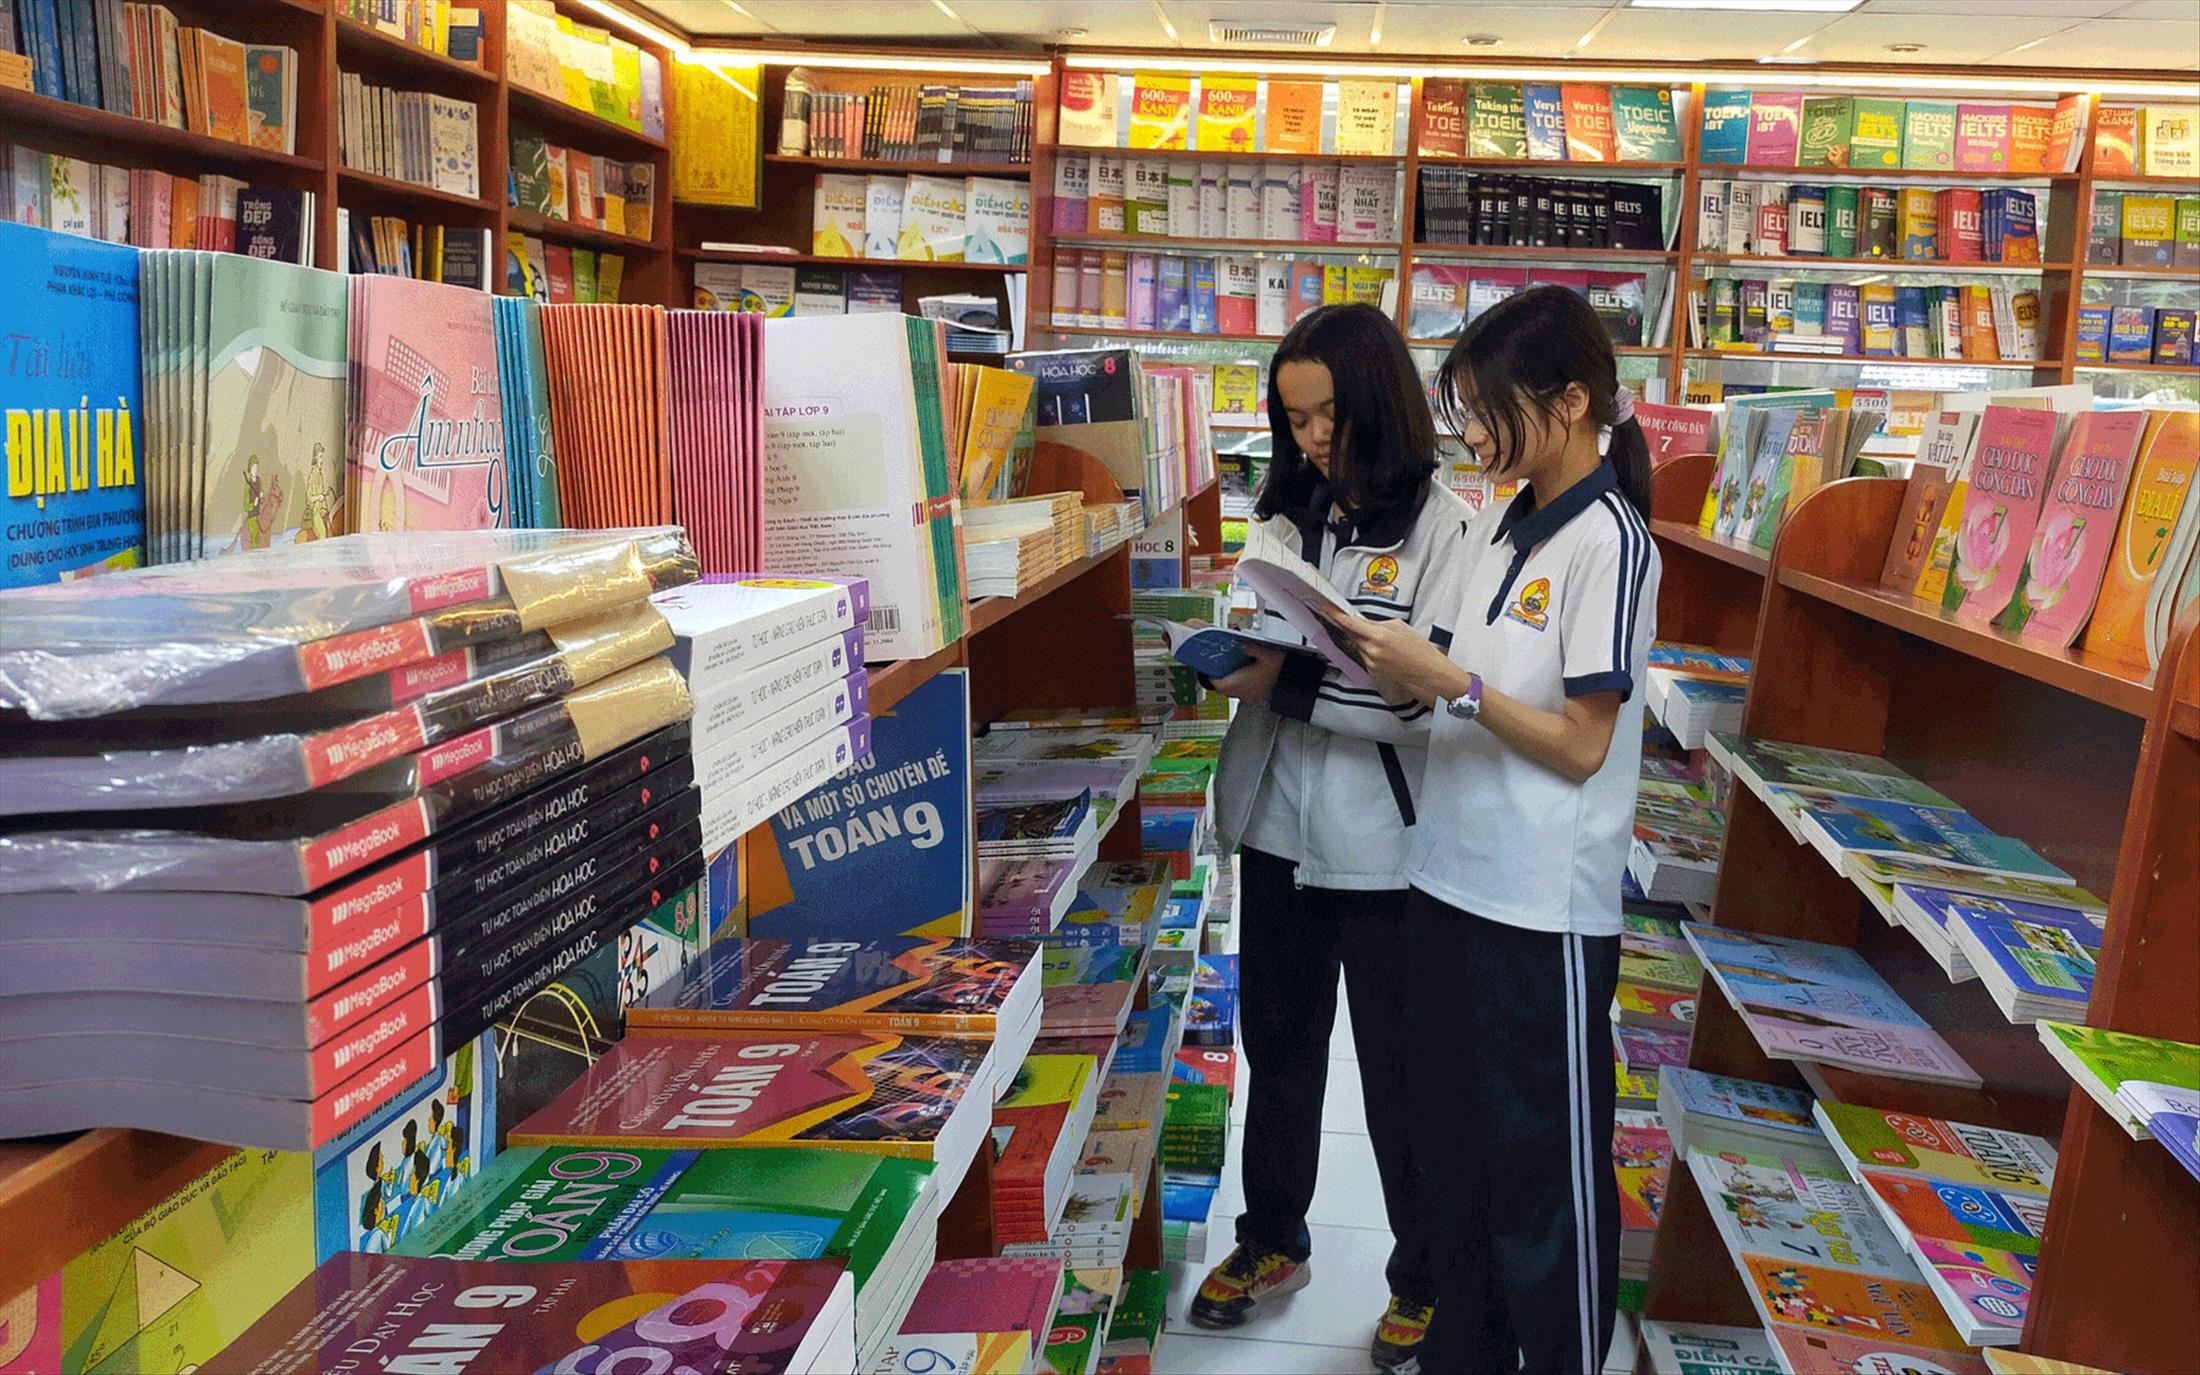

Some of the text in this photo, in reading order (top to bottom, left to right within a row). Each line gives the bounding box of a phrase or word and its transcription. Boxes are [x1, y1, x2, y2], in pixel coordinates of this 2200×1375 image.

[1141, 88, 1164, 102] 600
[1208, 88, 1232, 102] 600
[1427, 101, 1458, 116] Taking
[1476, 99, 1507, 114] Taking
[1534, 100, 1554, 116] Very
[1573, 100, 1592, 116] Very
[1620, 104, 1670, 123] TOEIC
[1572, 113, 1610, 130] TOEI
[1908, 121, 1952, 138] IELTS
[1960, 121, 2008, 138] IELTS
[1516, 142, 1527, 157] 2
[1613, 200, 1642, 215] IELTS
[2006, 196, 2035, 217] IELTS
[243, 209, 273, 226] ĐẸP
[2133, 239, 2160, 248] BASIC
[1412, 284, 1456, 302] IELTS
[1590, 290, 1634, 309] IELTS
[1626, 313, 1638, 327] 6
[1103, 356, 1117, 375] 8
[1855, 398, 1889, 409] 5500
[1667, 419, 1689, 433] CÔNG
[6, 395, 136, 509] ĐỊA LÍ HÀ
[1659, 435, 1673, 453] 7
[2136, 489, 2161, 524] ĐỊA
[6, 519, 60, 542] CHƯƠNG
[1164, 540, 1175, 553] 8
[805, 789, 842, 824] MỘT
[843, 777, 865, 810] SỐ
[867, 759, 928, 800] CHUYÊN
[927, 746, 952, 778] ĐỀ
[343, 822, 400, 860] MegaBook
[788, 800, 945, 871] TOÁN 9
[347, 876, 403, 916] MegaBook
[344, 919, 400, 960] MegaBook
[749, 956, 849, 1007] TOÁN
[806, 941, 862, 954] 9
[350, 966, 407, 1009] MegaBook
[888, 1016, 921, 1029] TOÁN 9
[350, 1010, 408, 1056] MegaBook
[350, 1057, 407, 1106] MegaBook
[662, 1063, 785, 1131] TOÁN
[737, 1042, 801, 1060] 9
[548, 1151, 643, 1181] 9
[1992, 1171, 2042, 1188] 6
[122, 1226, 143, 1245] CỦA
[143, 1216, 157, 1233] BỘ
[157, 1201, 180, 1222] GIÁO
[180, 1190, 199, 1208] DỤC
[199, 1178, 211, 1194] VÀ
[494, 1200, 532, 1229] PHÁP
[521, 1178, 559, 1200] GIẢI
[454, 1284, 538, 1310] 9
[533, 1277, 579, 1317] TẬP HAI
[344, 1282, 445, 1355] DẠY HỌC
[903, 1347, 957, 1374] 9
[1673, 1346, 1742, 1364] ĐIỂM
